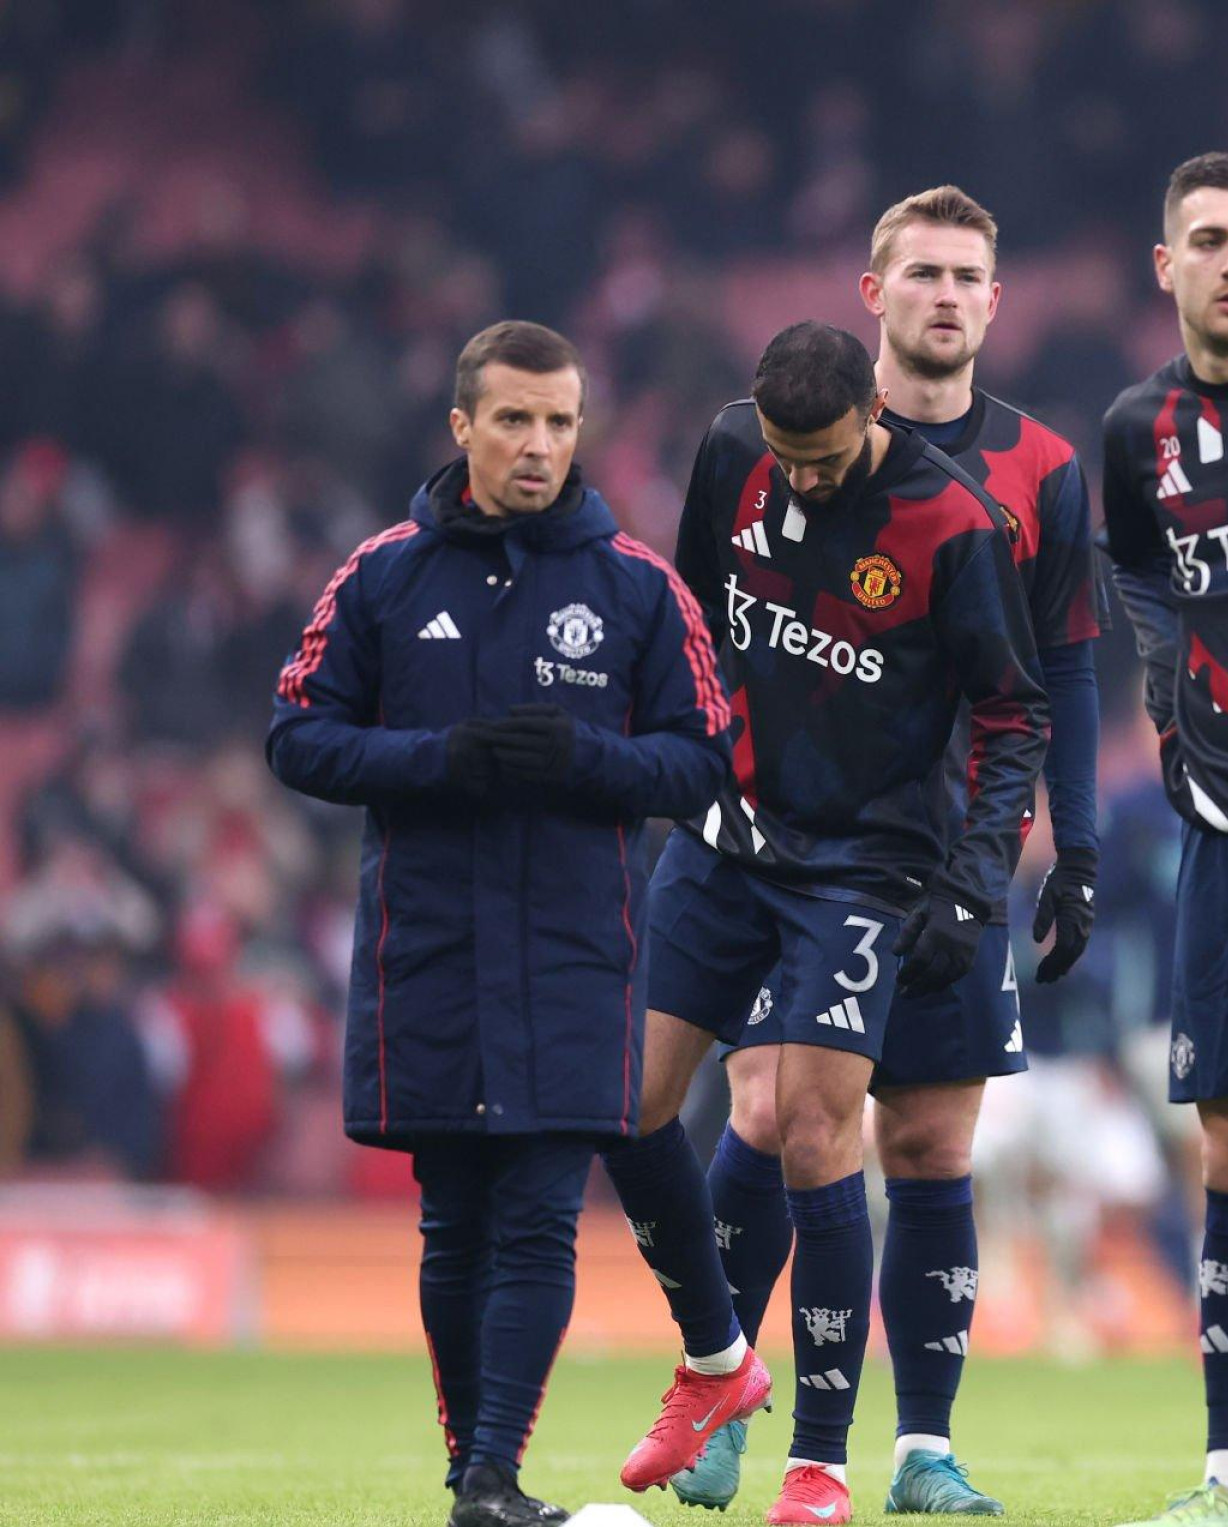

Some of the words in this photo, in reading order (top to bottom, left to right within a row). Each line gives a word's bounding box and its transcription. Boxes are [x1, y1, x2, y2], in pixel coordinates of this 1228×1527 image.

[1160, 436, 1181, 459] 20
[754, 490, 768, 510] 3
[765, 601, 885, 684] Tezos
[556, 663, 609, 688] Tezos
[833, 914, 885, 993] 3
